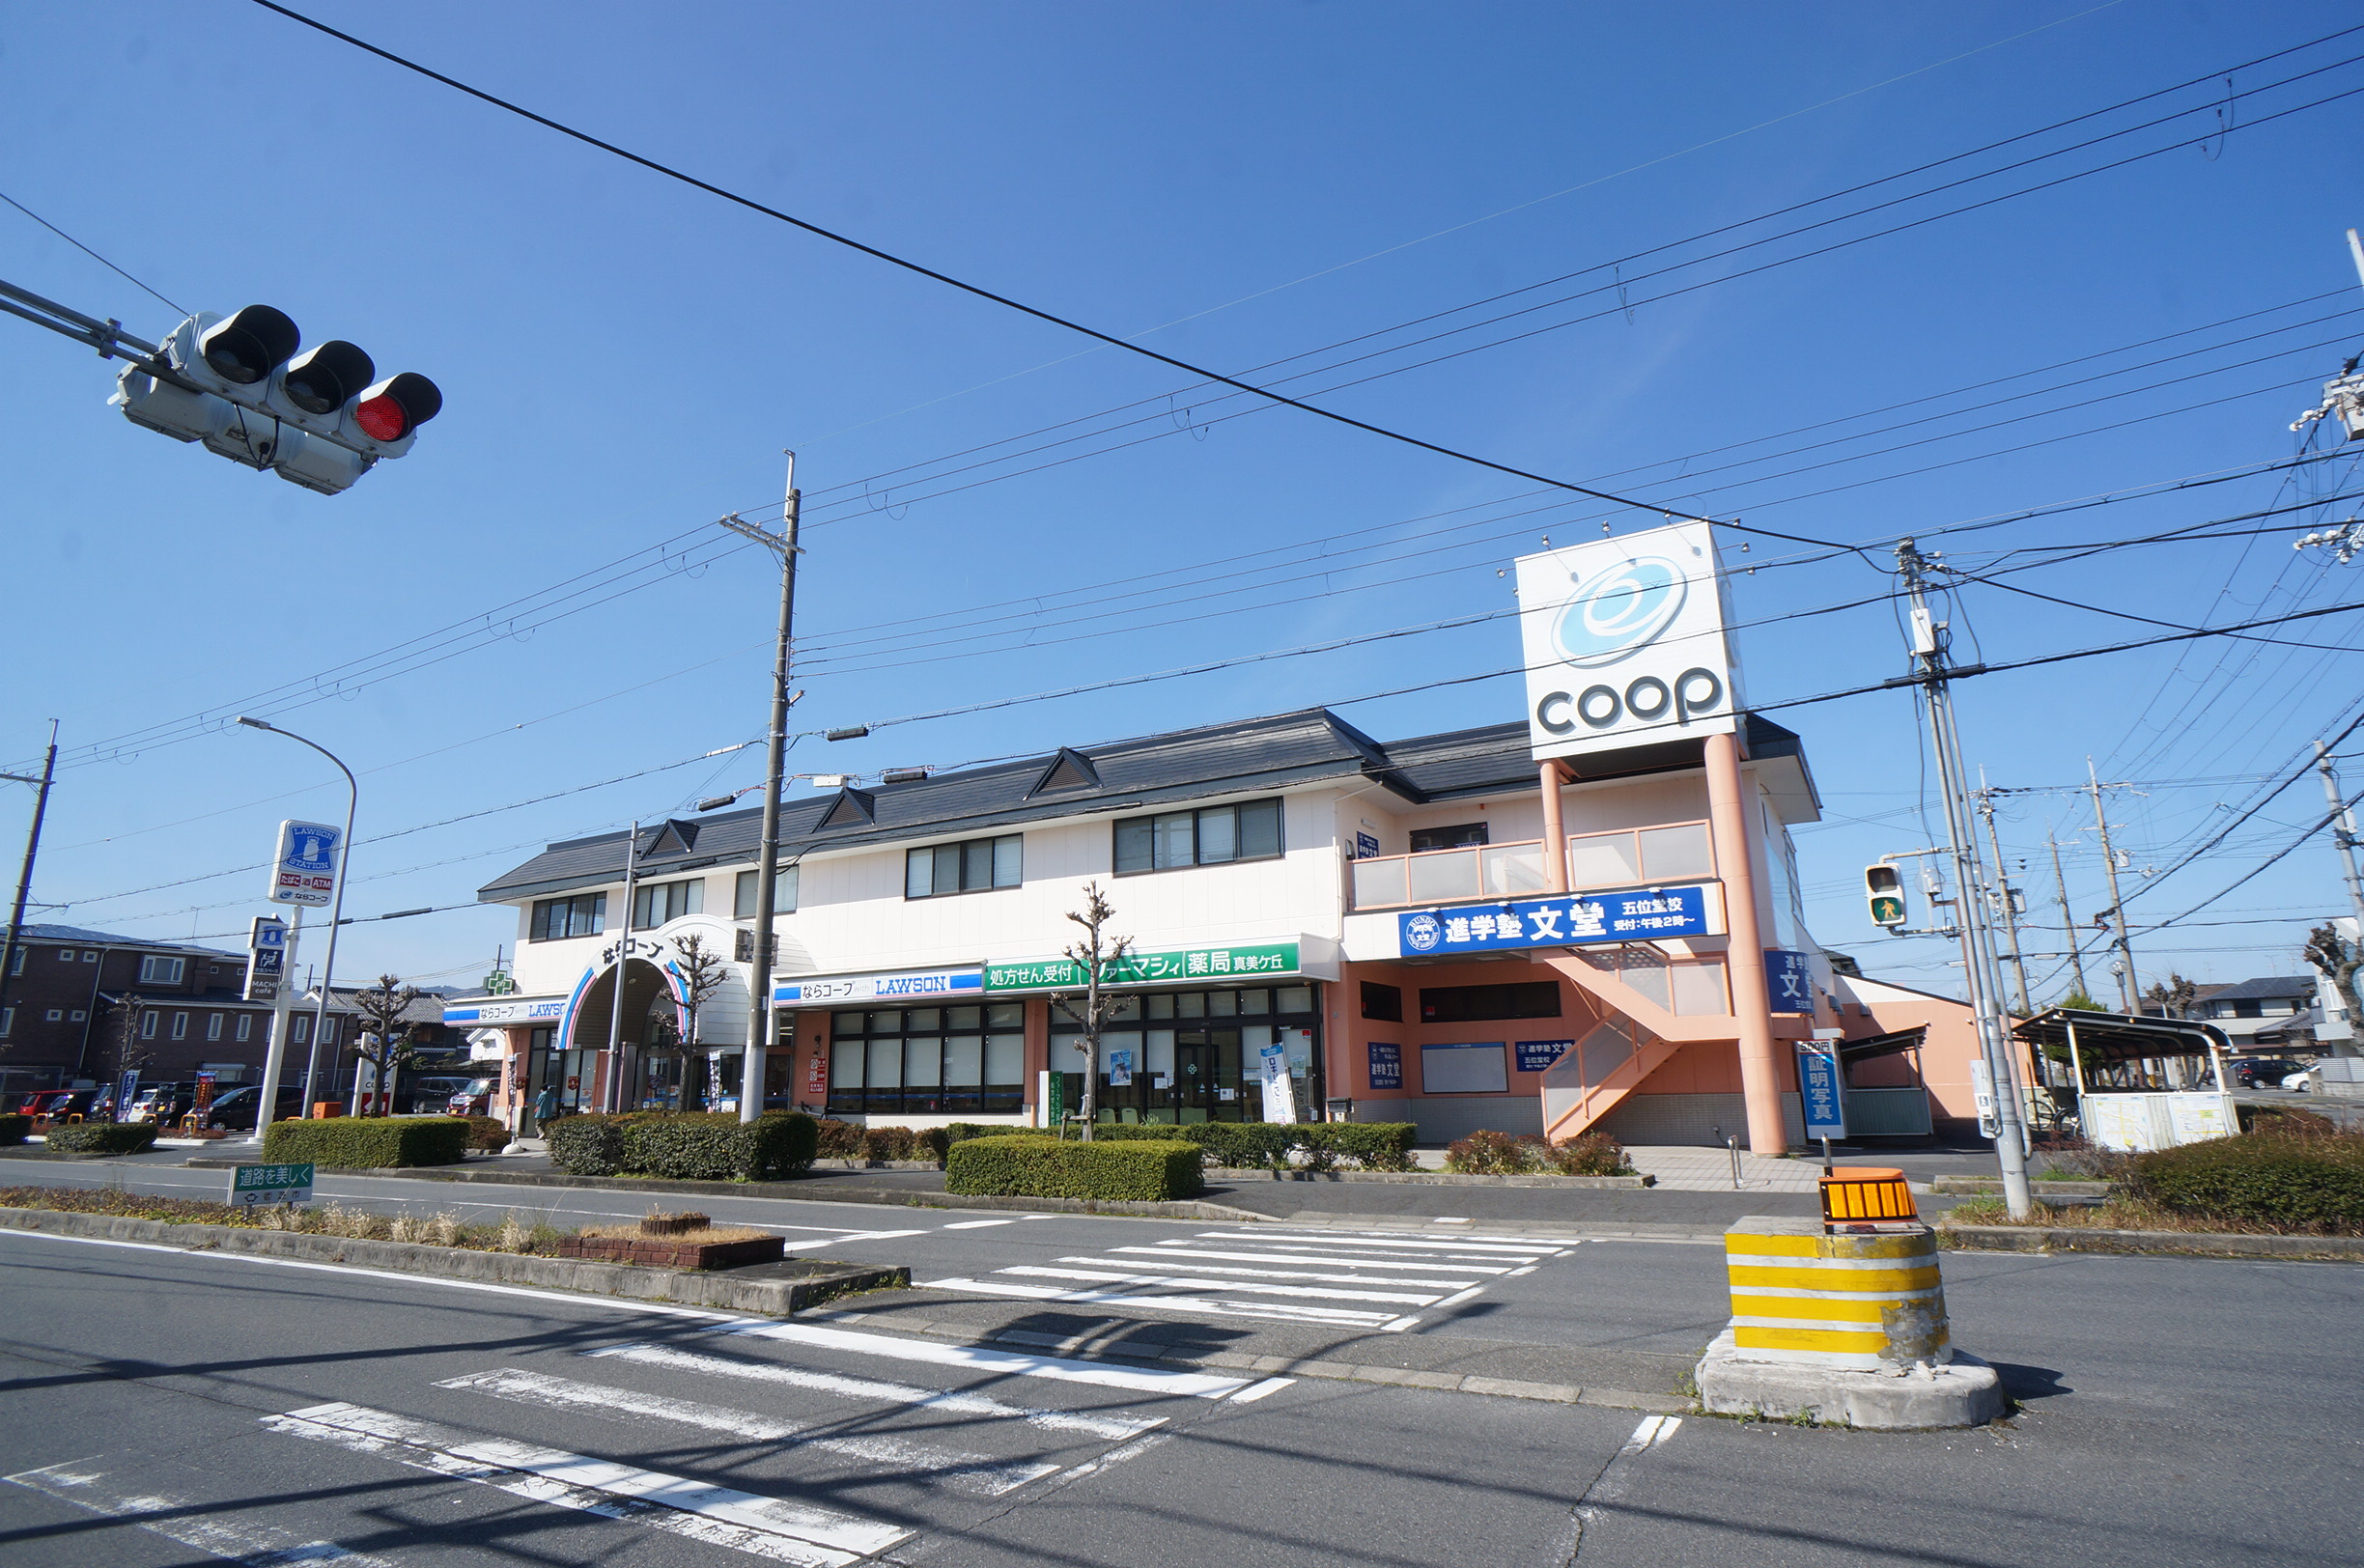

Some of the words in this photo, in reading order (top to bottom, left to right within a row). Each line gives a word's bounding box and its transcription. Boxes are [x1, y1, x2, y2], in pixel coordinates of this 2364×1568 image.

[1537, 667, 1721, 734] coop
[294, 826, 334, 841] LAWSON
[288, 857, 329, 870] STATION
[280, 875, 300, 885] たばこ
[312, 879, 331, 888] ATM
[295, 892, 328, 903] ならコープ
[1621, 898, 1684, 916] 五位堂校
[1445, 913, 1523, 943] 進学塾
[990, 963, 1072, 986] 処方せん受付
[1188, 951, 1230, 974] 薬局
[802, 981, 856, 998] ならコープ
[854, 983, 870, 994] with
[876, 976, 946, 995] LAWSON
[481, 1006, 515, 1019] ならコープ
[1799, 1040, 1831, 1052] 500円
[1807, 1055, 1833, 1121] 証明写真
[239, 1165, 310, 1187] 道路を美しく
